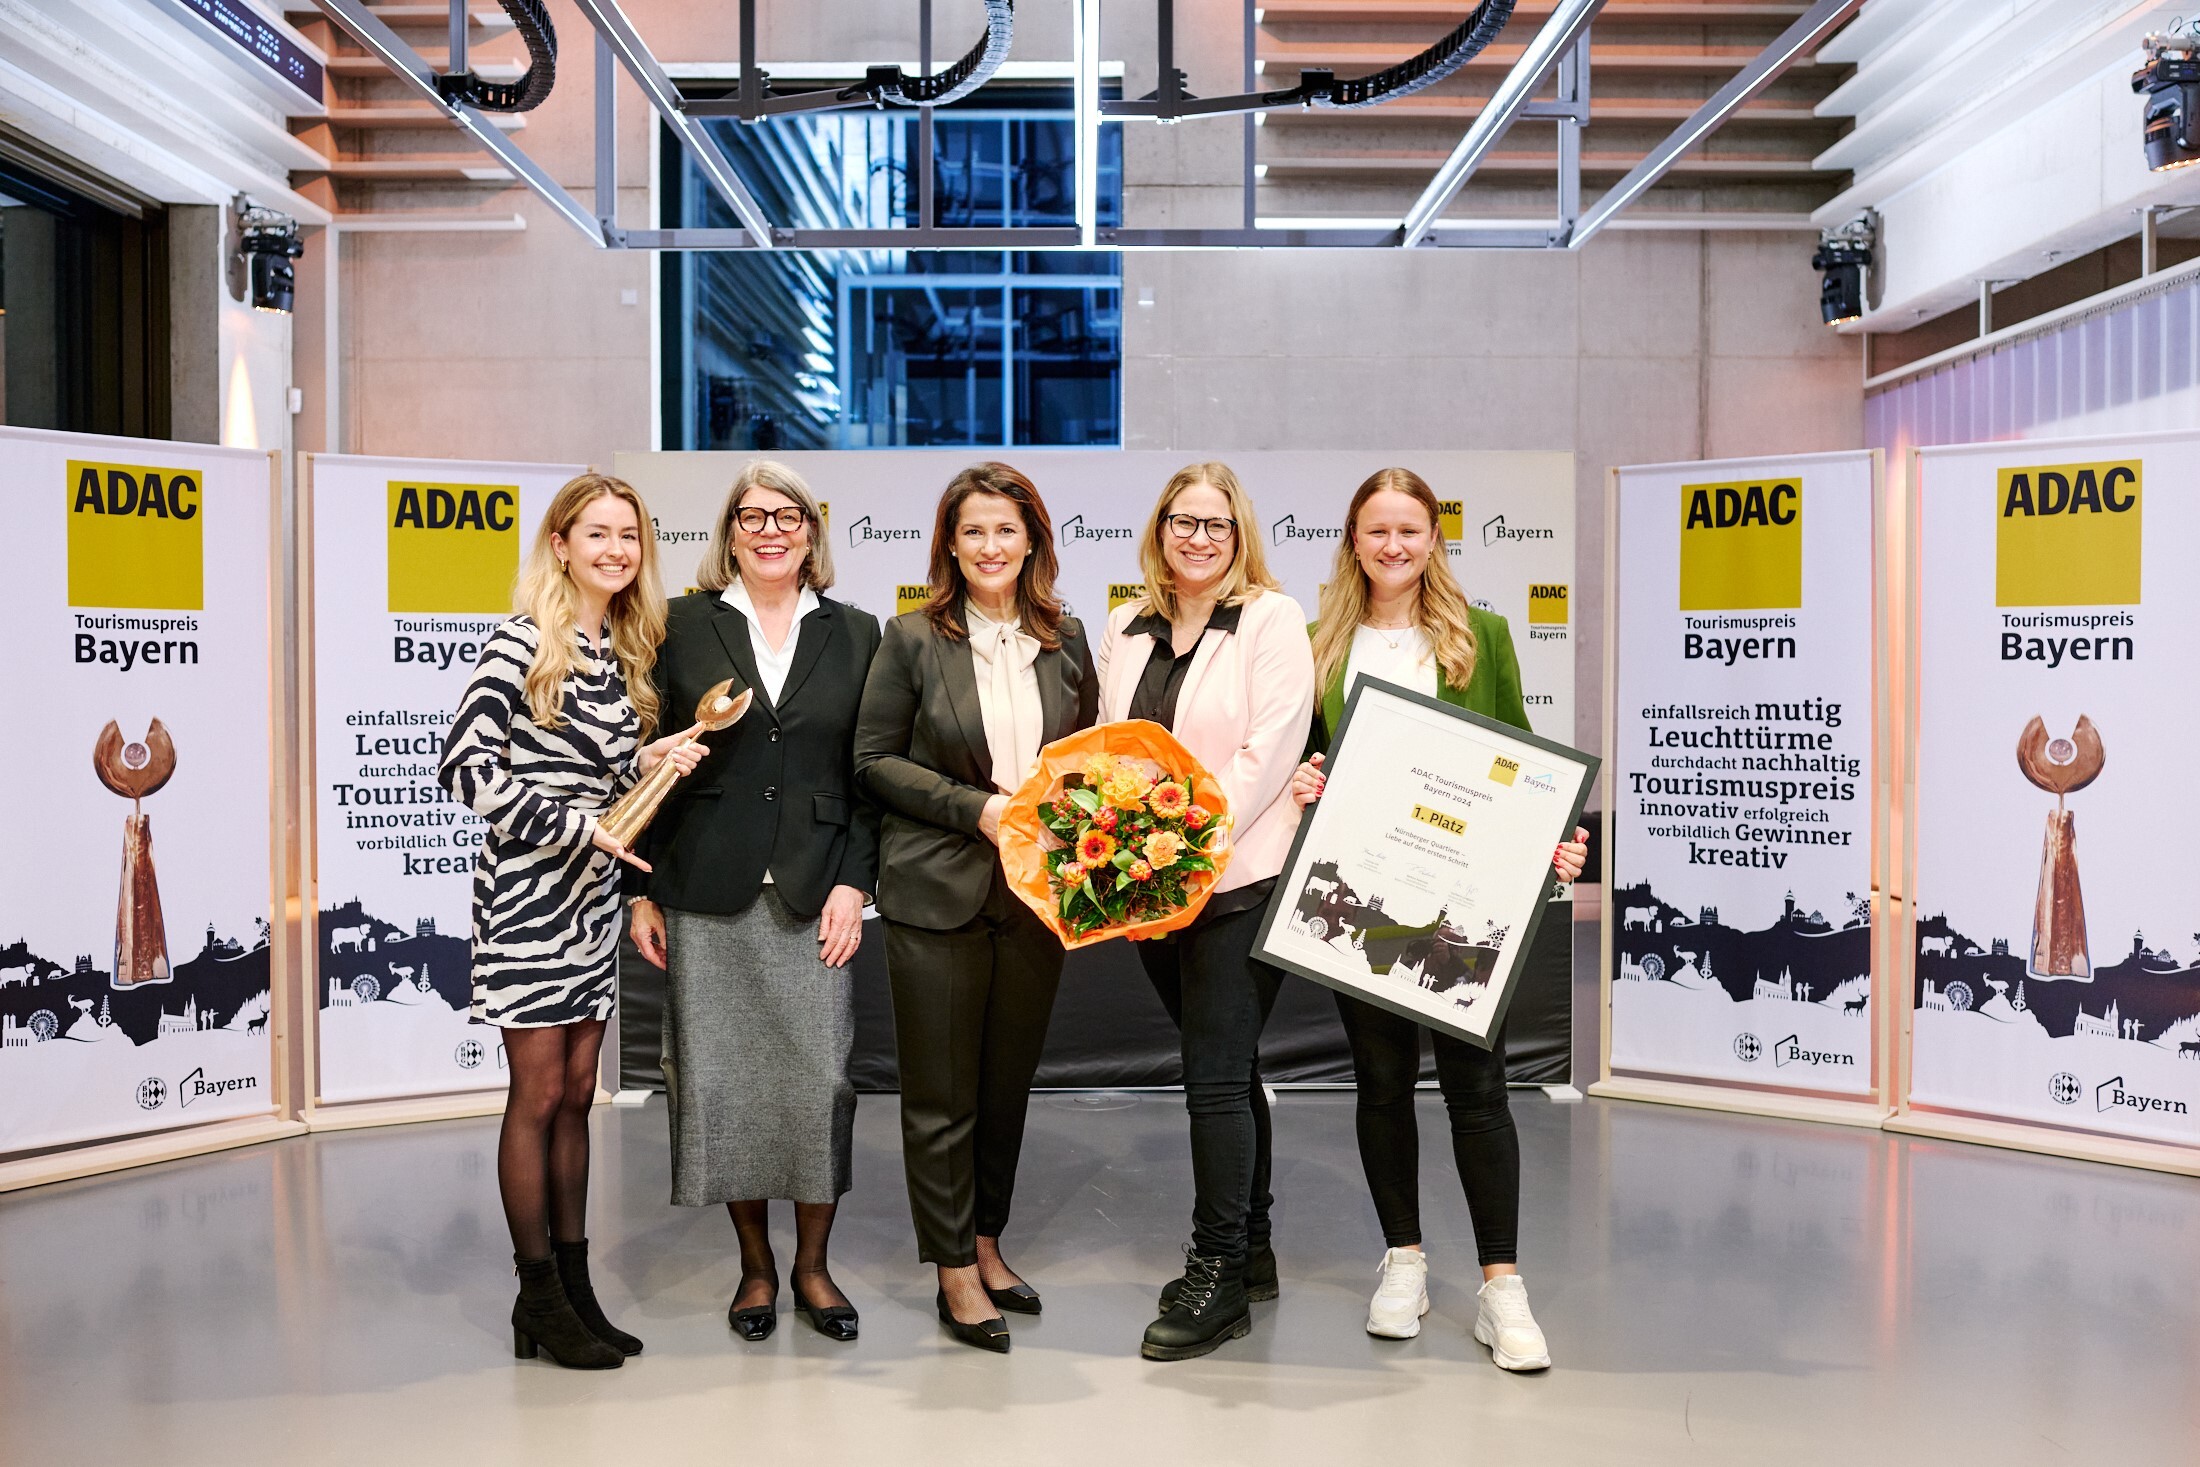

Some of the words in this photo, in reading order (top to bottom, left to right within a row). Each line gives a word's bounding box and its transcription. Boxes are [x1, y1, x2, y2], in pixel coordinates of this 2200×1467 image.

[73, 467, 197, 521] ADAC
[2003, 466, 2136, 518] ADAC
[393, 487, 514, 532] ADAC
[1686, 483, 1797, 530] ADAC
[862, 526, 921, 543] Bayern
[1074, 525, 1133, 542] Bayern
[1285, 525, 1343, 541] Bayern
[1496, 525, 1554, 542] Bayern
[1530, 585, 1567, 599] ADAC
[74, 613, 198, 633] Tourismuspreis
[394, 618, 501, 635] Tourismuspre
[1684, 613, 1796, 632] Tourismuspreis
[2001, 610, 2134, 630] Tourismuspreis
[1530, 630, 1567, 641] Bayern
[74, 633, 199, 672] Bayern
[394, 636, 486, 670] Baye
[1684, 633, 1796, 667] Bayern
[2001, 632, 2134, 669] Bayern
[1522, 695, 1554, 706] ern
[345, 710, 456, 726] einfallsreic
[1641, 704, 1751, 720] einfallsreich
[1754, 697, 1842, 728] mutig
[355, 731, 445, 756] Leuch
[1649, 725, 1833, 750] Leuchttürme
[358, 764, 437, 777] durchdac
[1494, 757, 1519, 772] ADAC
[1651, 755, 1738, 770] durchdacht
[1741, 754, 1861, 777] nachhaltig
[1410, 766, 1434, 781] ADAC
[1435, 775, 1494, 802] Tourismuspreis
[1423, 783, 1451, 800] Bayern
[1452, 794, 1472, 808] 2024
[1524, 775, 1557, 793] Bayern
[1629, 772, 1855, 804] Tourismuspreis
[346, 808, 456, 829] innovativ
[1415, 807, 1425, 821] 1.
[1429, 812, 1464, 835] Platz
[1639, 798, 1739, 819] innovativ
[1743, 807, 1829, 824] erfolgreich
[356, 834, 447, 850] vorbildlich
[1395, 827, 1430, 846] Nürnberger
[1430, 840, 1460, 857] Quartiere
[1647, 825, 1731, 840] vorbildlich
[1735, 824, 1852, 846] Gewinner
[1385, 832, 1402, 844] Liebe
[1402, 839, 1414, 849] auf
[1414, 844, 1426, 853] den
[1427, 849, 1447, 861] ersten
[1448, 856, 1469, 869] Schritt
[1688, 842, 1788, 869] kreativ
[402, 852, 481, 876] kreat
[1789, 1046, 1854, 1066] Bayern
[194, 1076, 257, 1097] Bayern
[2112, 1089, 2188, 1115] Bayern
